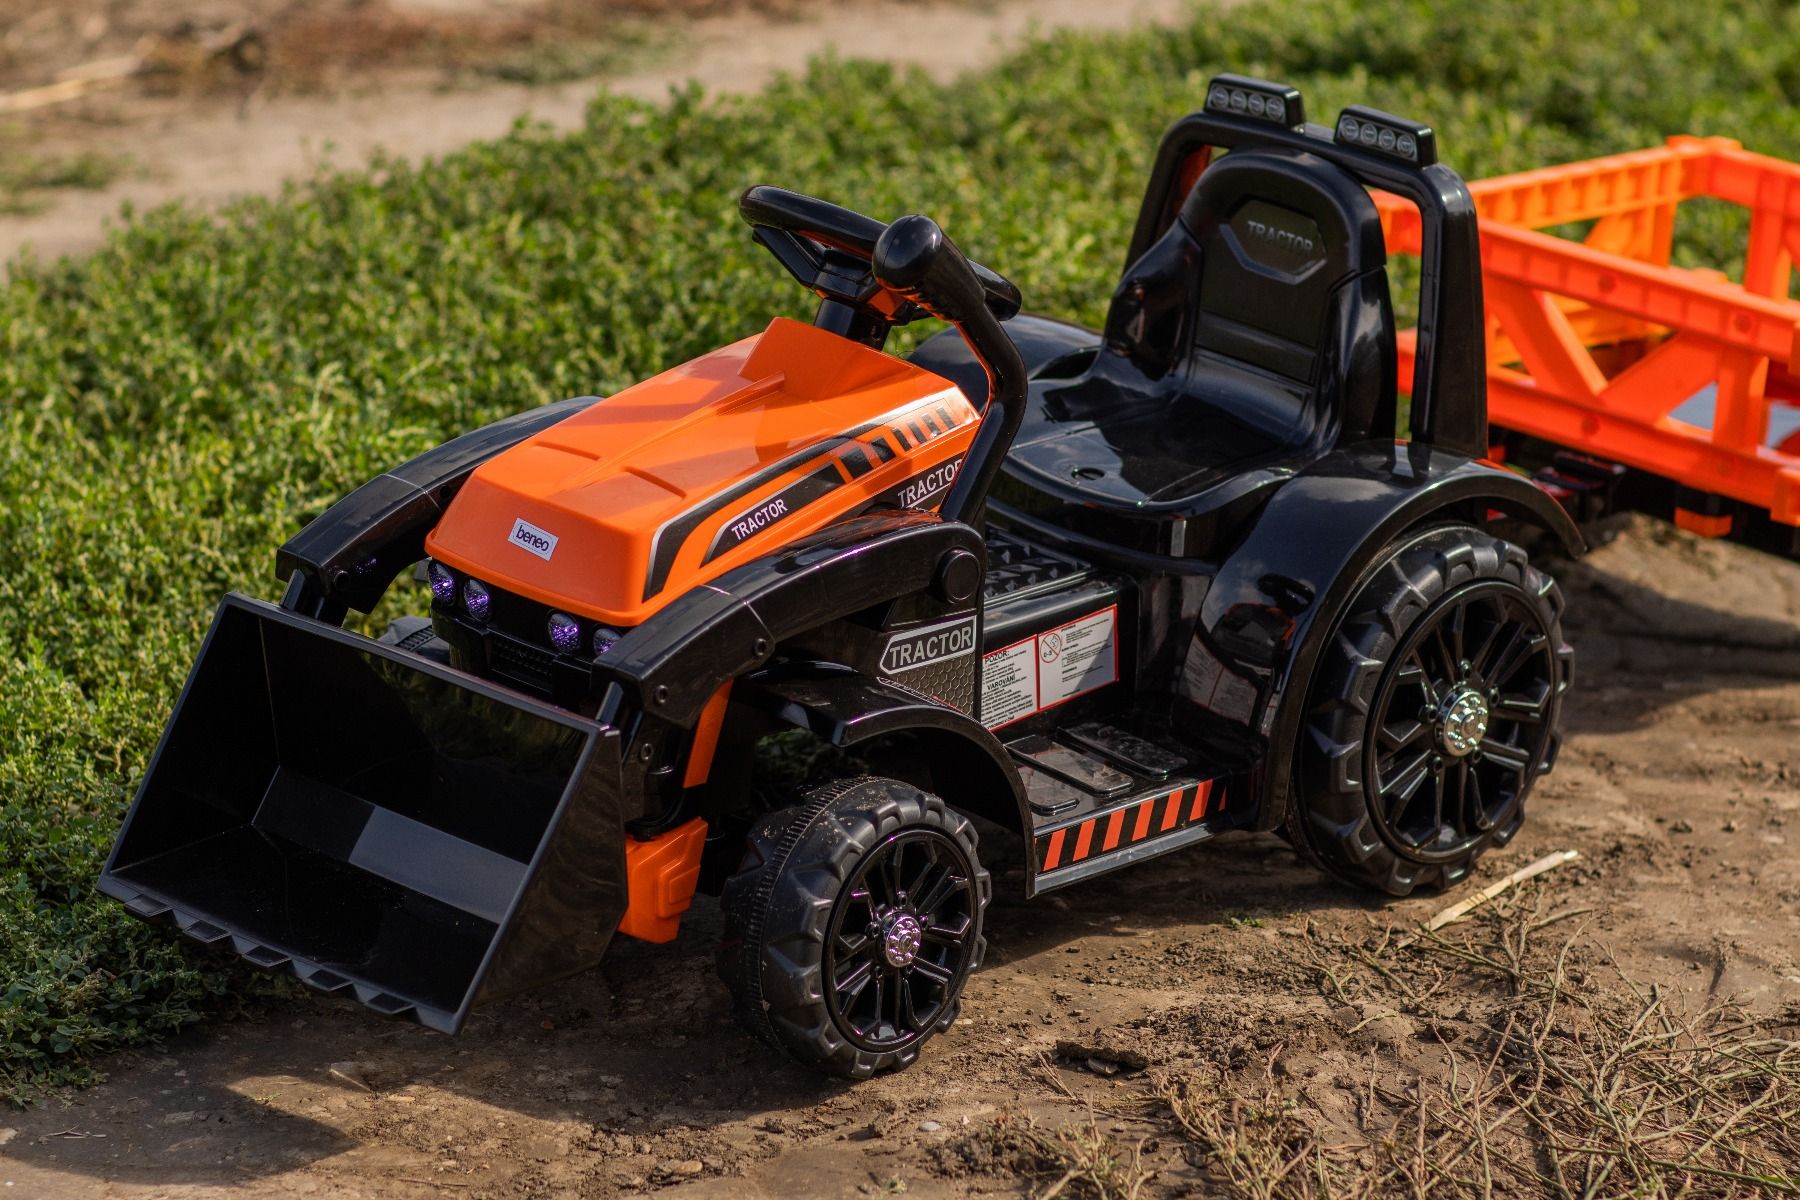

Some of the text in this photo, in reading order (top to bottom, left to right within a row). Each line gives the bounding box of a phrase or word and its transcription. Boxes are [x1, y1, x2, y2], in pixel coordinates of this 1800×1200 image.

[1247, 220, 1313, 251] TRACTOR
[731, 498, 788, 541] TRACTOR
[516, 525, 549, 551] beneo
[889, 626, 972, 667] TRACTOR
